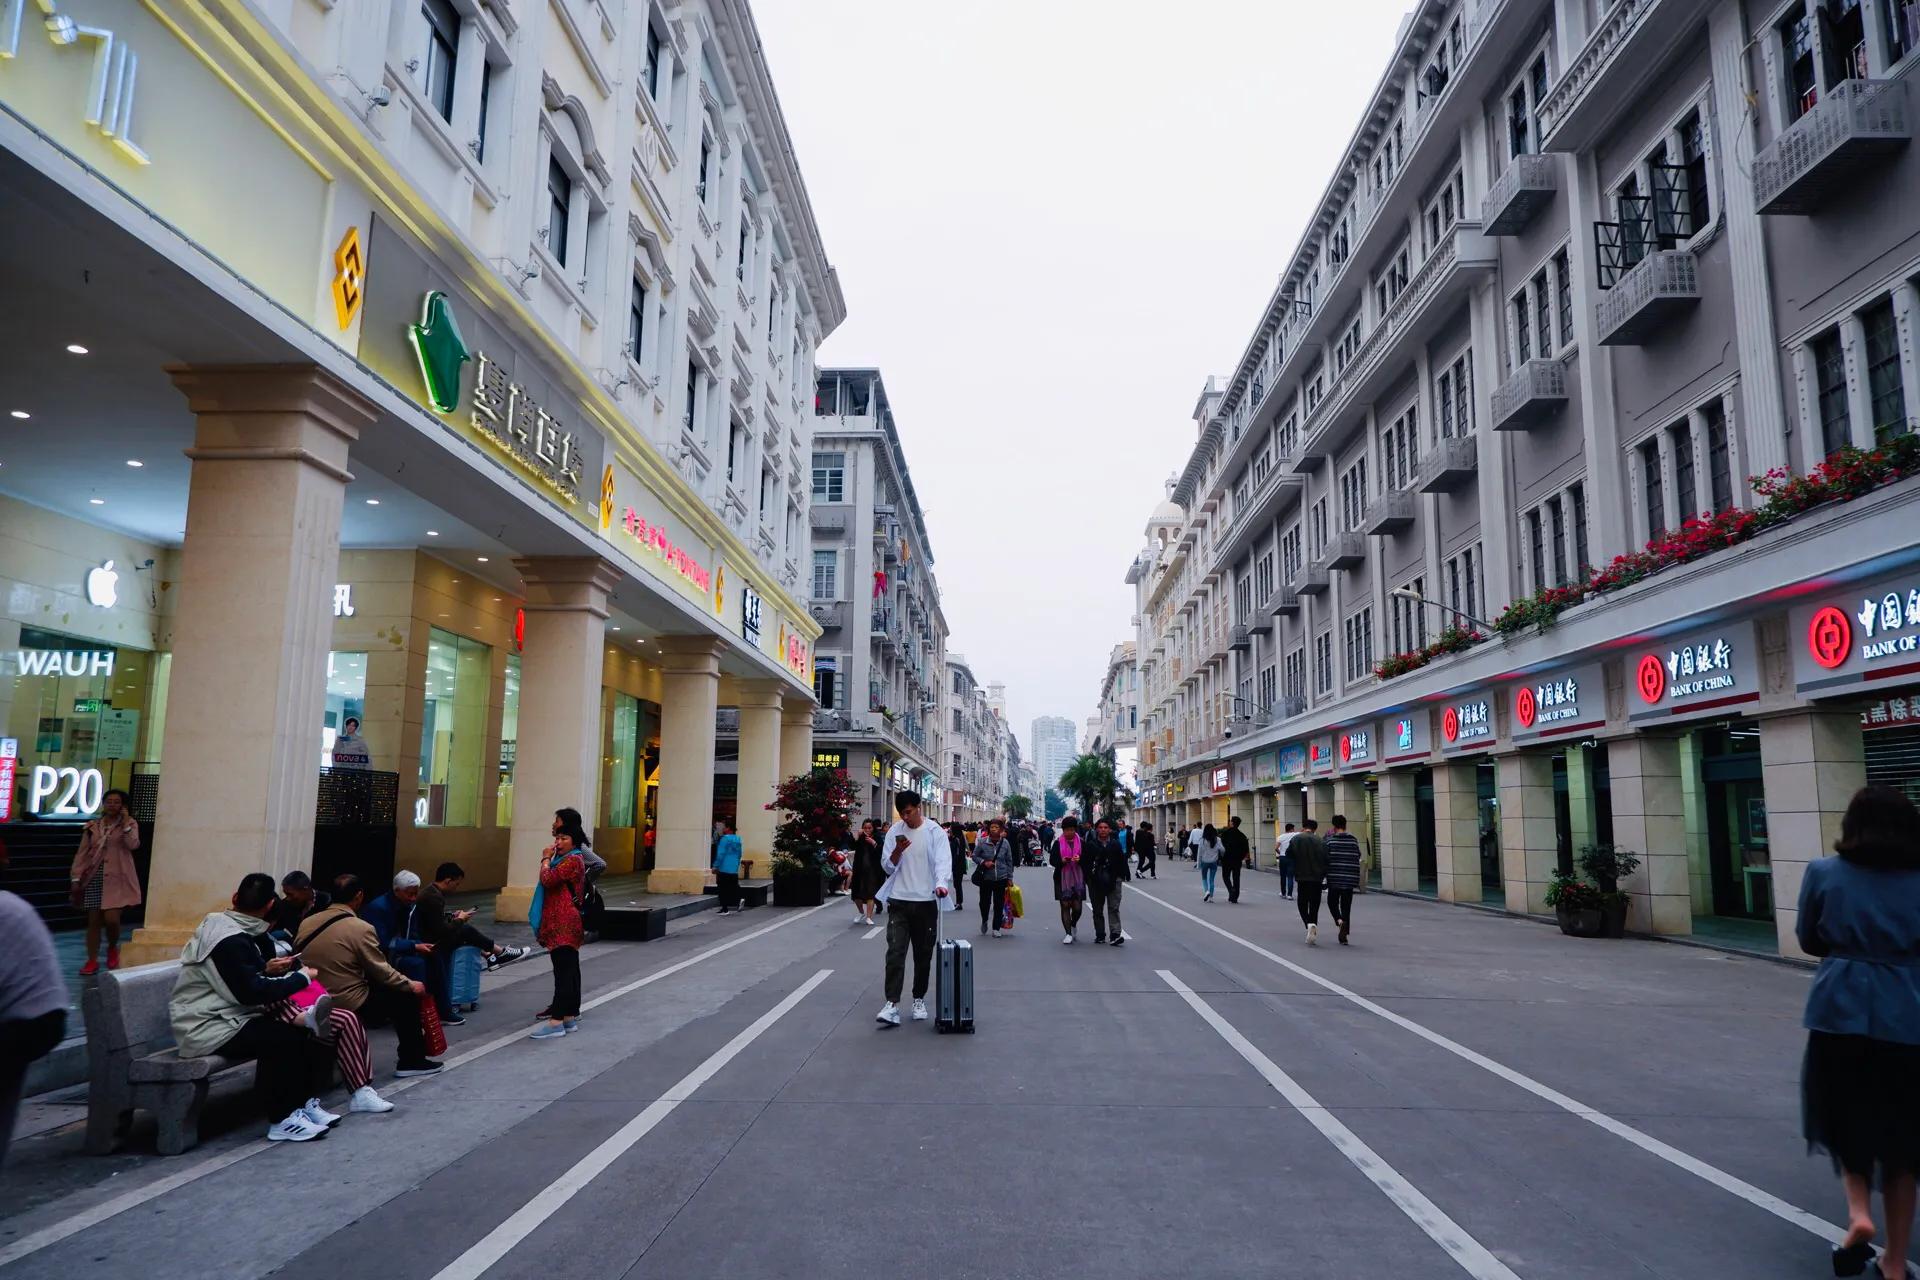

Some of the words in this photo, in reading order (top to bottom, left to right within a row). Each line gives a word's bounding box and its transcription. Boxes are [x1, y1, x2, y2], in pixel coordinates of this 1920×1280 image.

[1667, 638, 1731, 680] 中国银行
[1863, 640, 1898, 659] BANK
[1900, 635, 1917, 651] OF
[1536, 678, 1577, 710] 中国银行
[1671, 683, 1693, 697] BANK
[1692, 680, 1704, 692] OF
[1704, 675, 1733, 690] CHINA
[1458, 701, 1488, 727] 中国银行
[1538, 712, 1553, 723] BANK
[1552, 711, 1560, 720] OF
[1560, 708, 1578, 718] CHINA
[31, 765, 103, 814] P20
